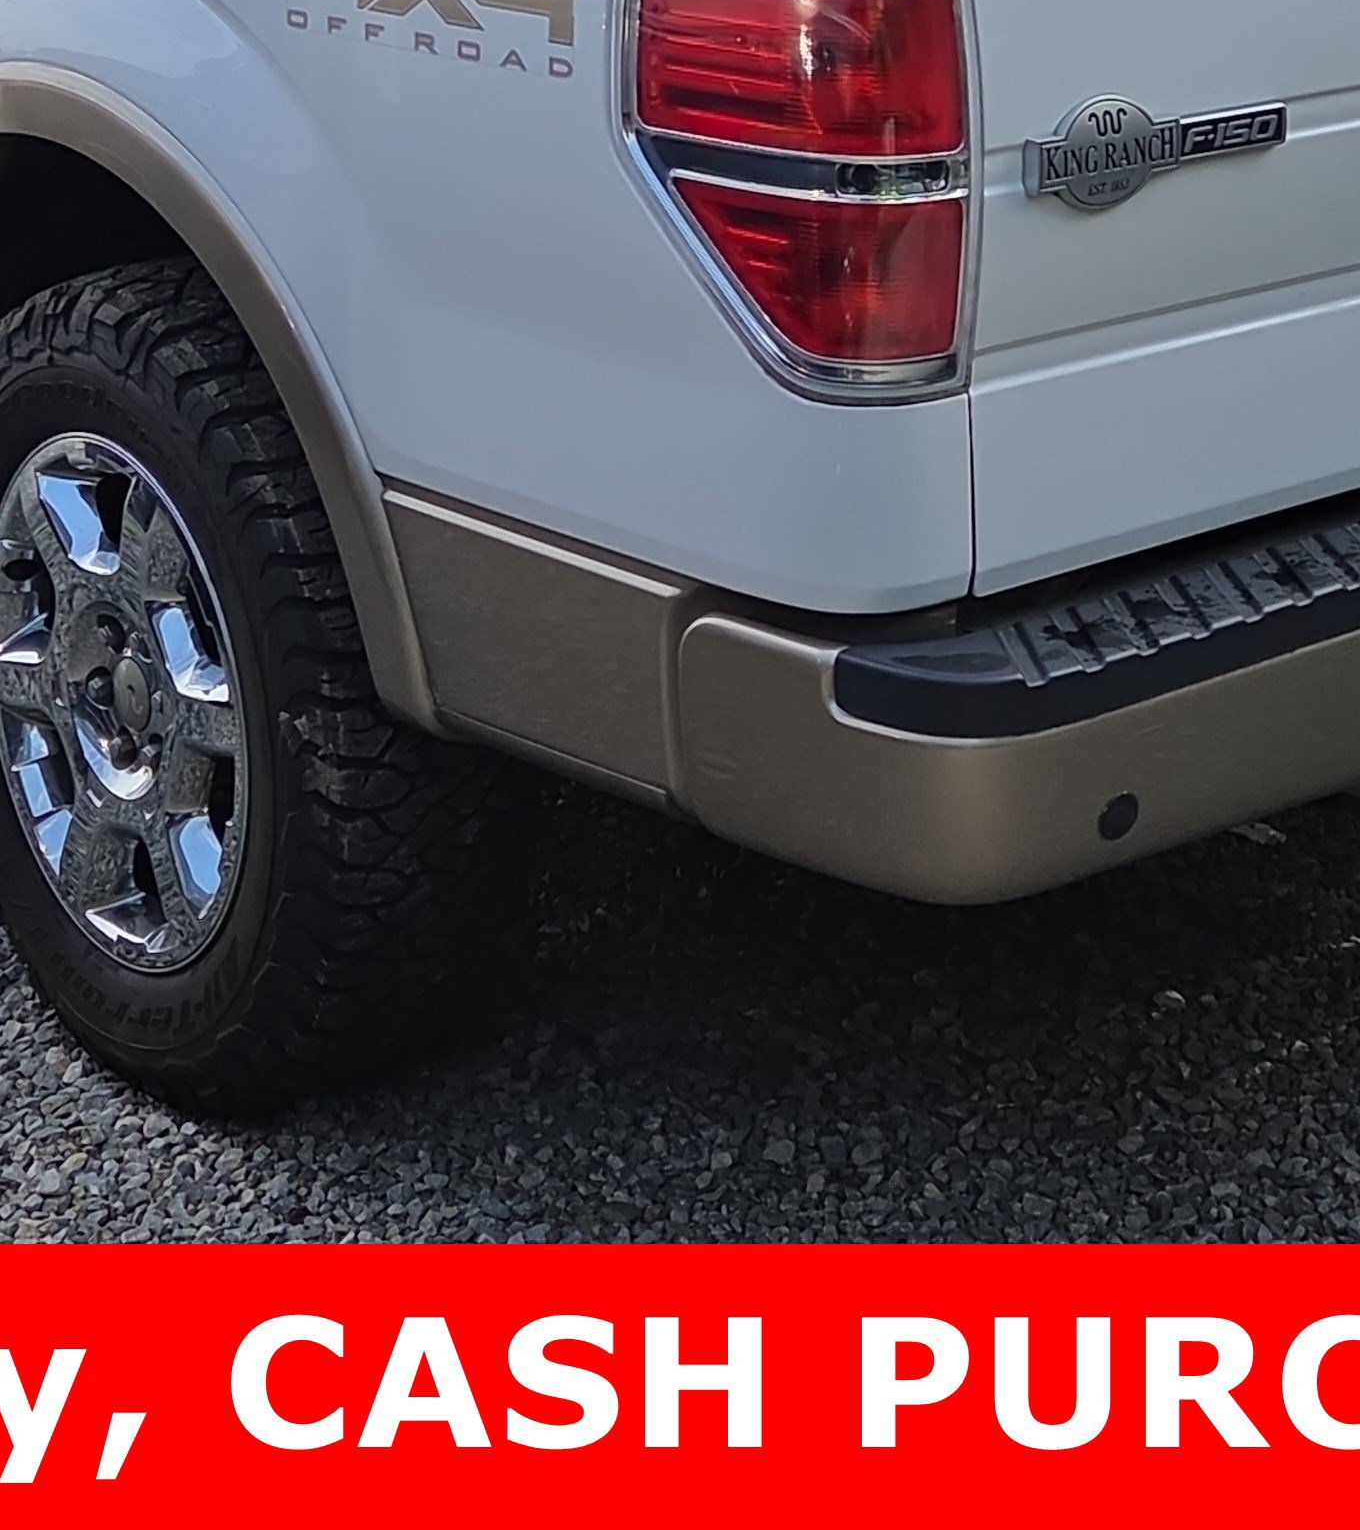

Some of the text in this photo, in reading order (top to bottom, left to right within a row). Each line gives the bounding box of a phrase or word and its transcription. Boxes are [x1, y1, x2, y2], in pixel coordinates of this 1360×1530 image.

[1045, 126, 1175, 181] KING RANCH
[1182, 113, 1280, 157] F-150
